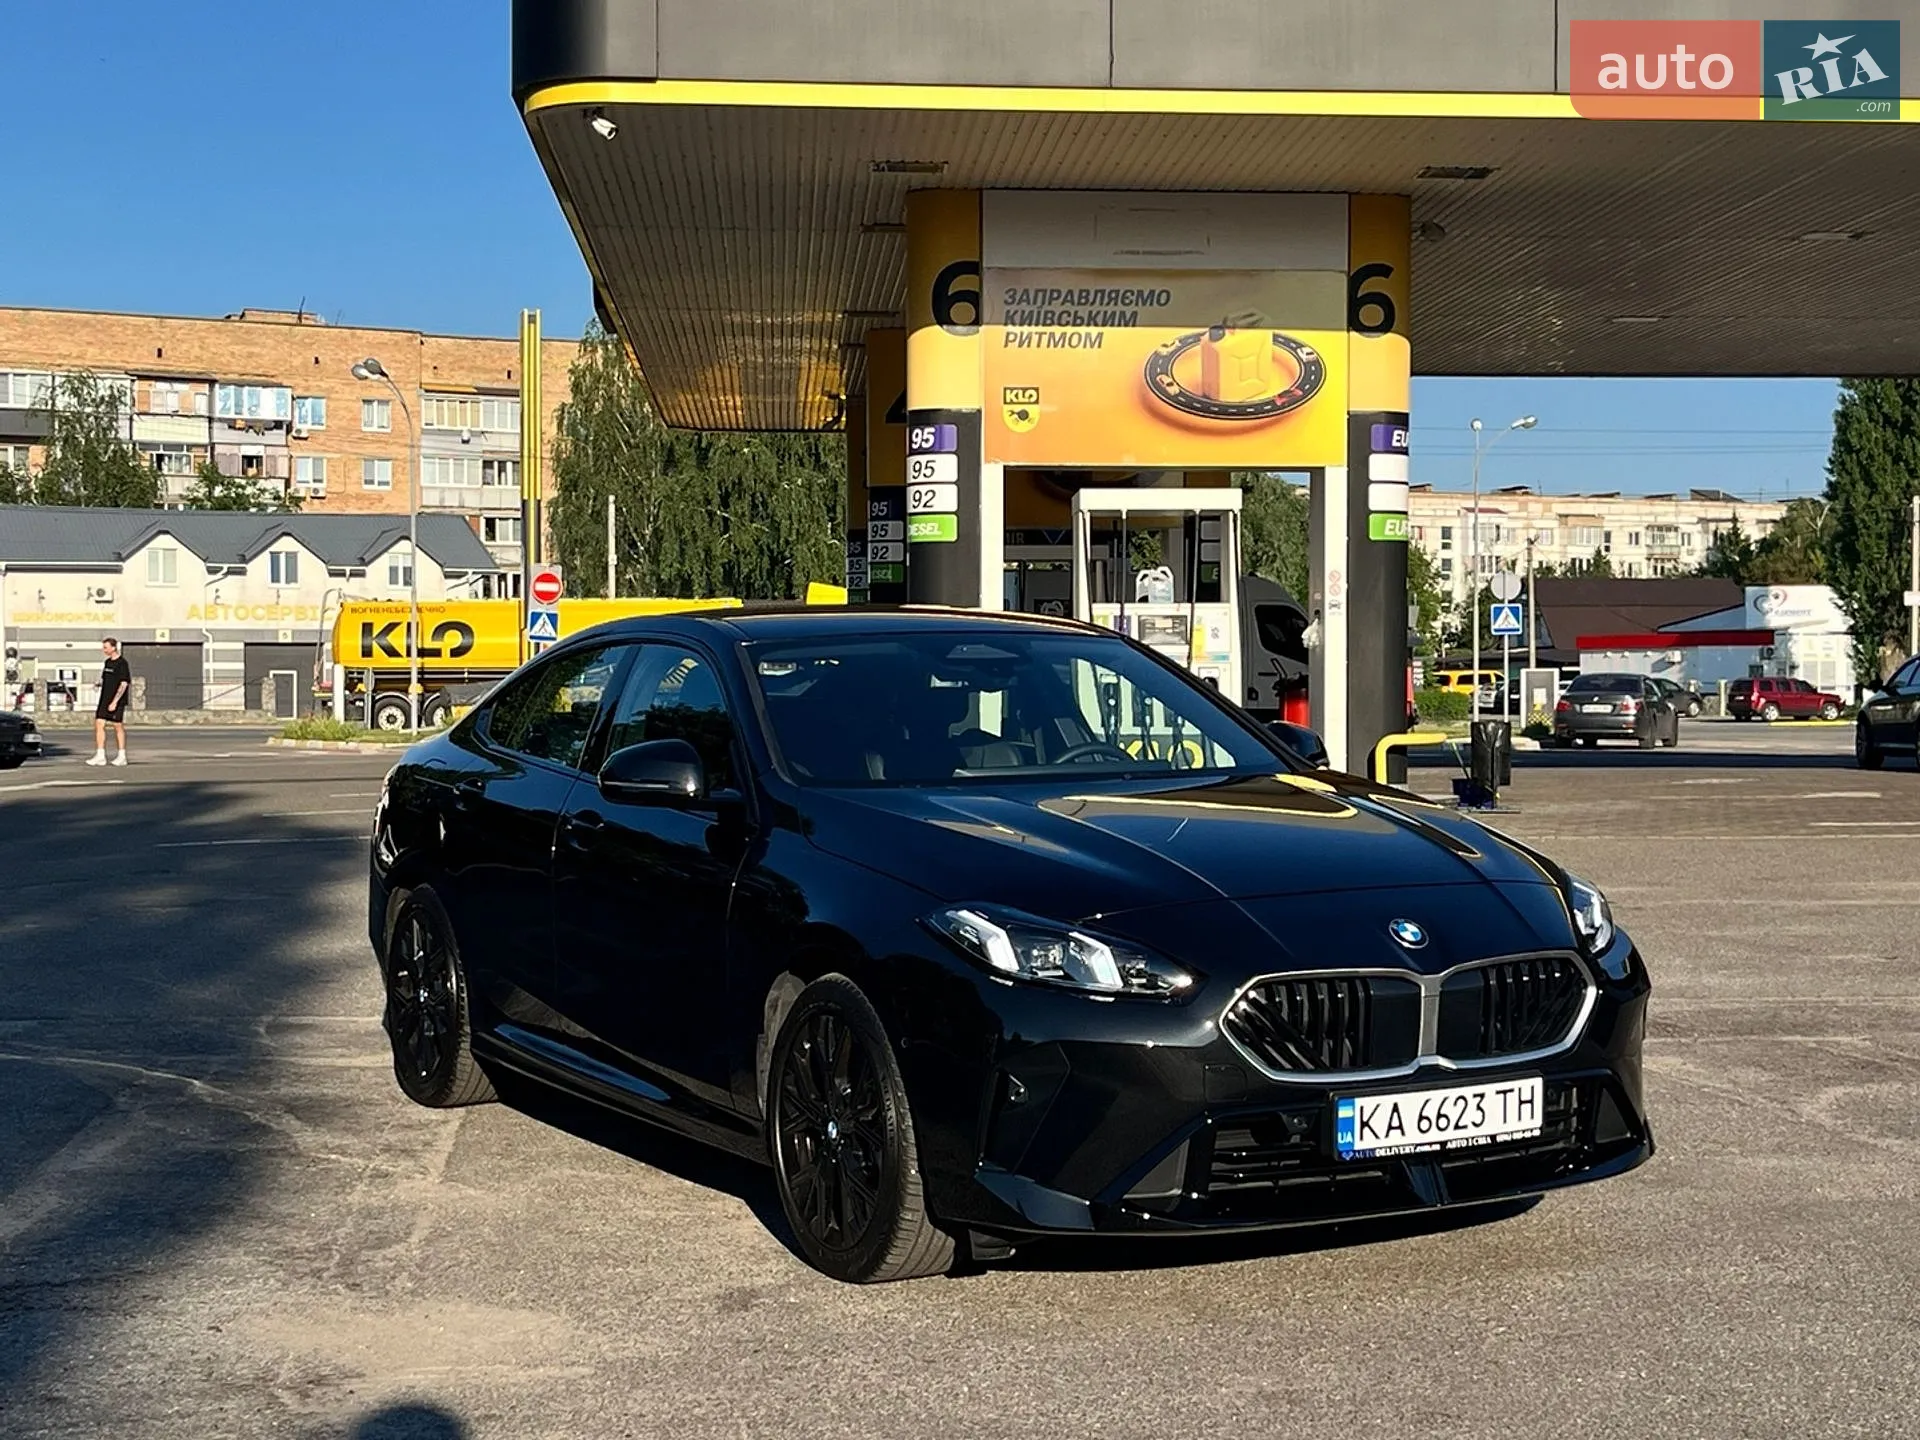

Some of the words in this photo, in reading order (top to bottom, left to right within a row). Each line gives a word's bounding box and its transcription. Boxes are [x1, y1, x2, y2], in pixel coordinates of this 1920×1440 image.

[932, 259, 980, 336] 6
[1003, 288, 1171, 307] ЗАПРАВЛЯЄМО
[1348, 263, 1396, 338] 6
[1003, 306, 1138, 327] КИЇВСЬКИМ
[1003, 331, 1104, 349] РИТМОМ
[1005, 389, 1038, 403] KLO
[911, 427, 936, 449] 95
[911, 460, 936, 480] 95
[871, 501, 888, 516] 95
[911, 489, 937, 509] 92
[871, 523, 889, 538] 95
[871, 545, 889, 560] 92
[361, 620, 475, 659] KLO
[1359, 1102, 1405, 1142] KA
[1416, 1092, 1486, 1134] 6623
[1496, 1085, 1535, 1124] TH
[1338, 1131, 1353, 1144] UA
